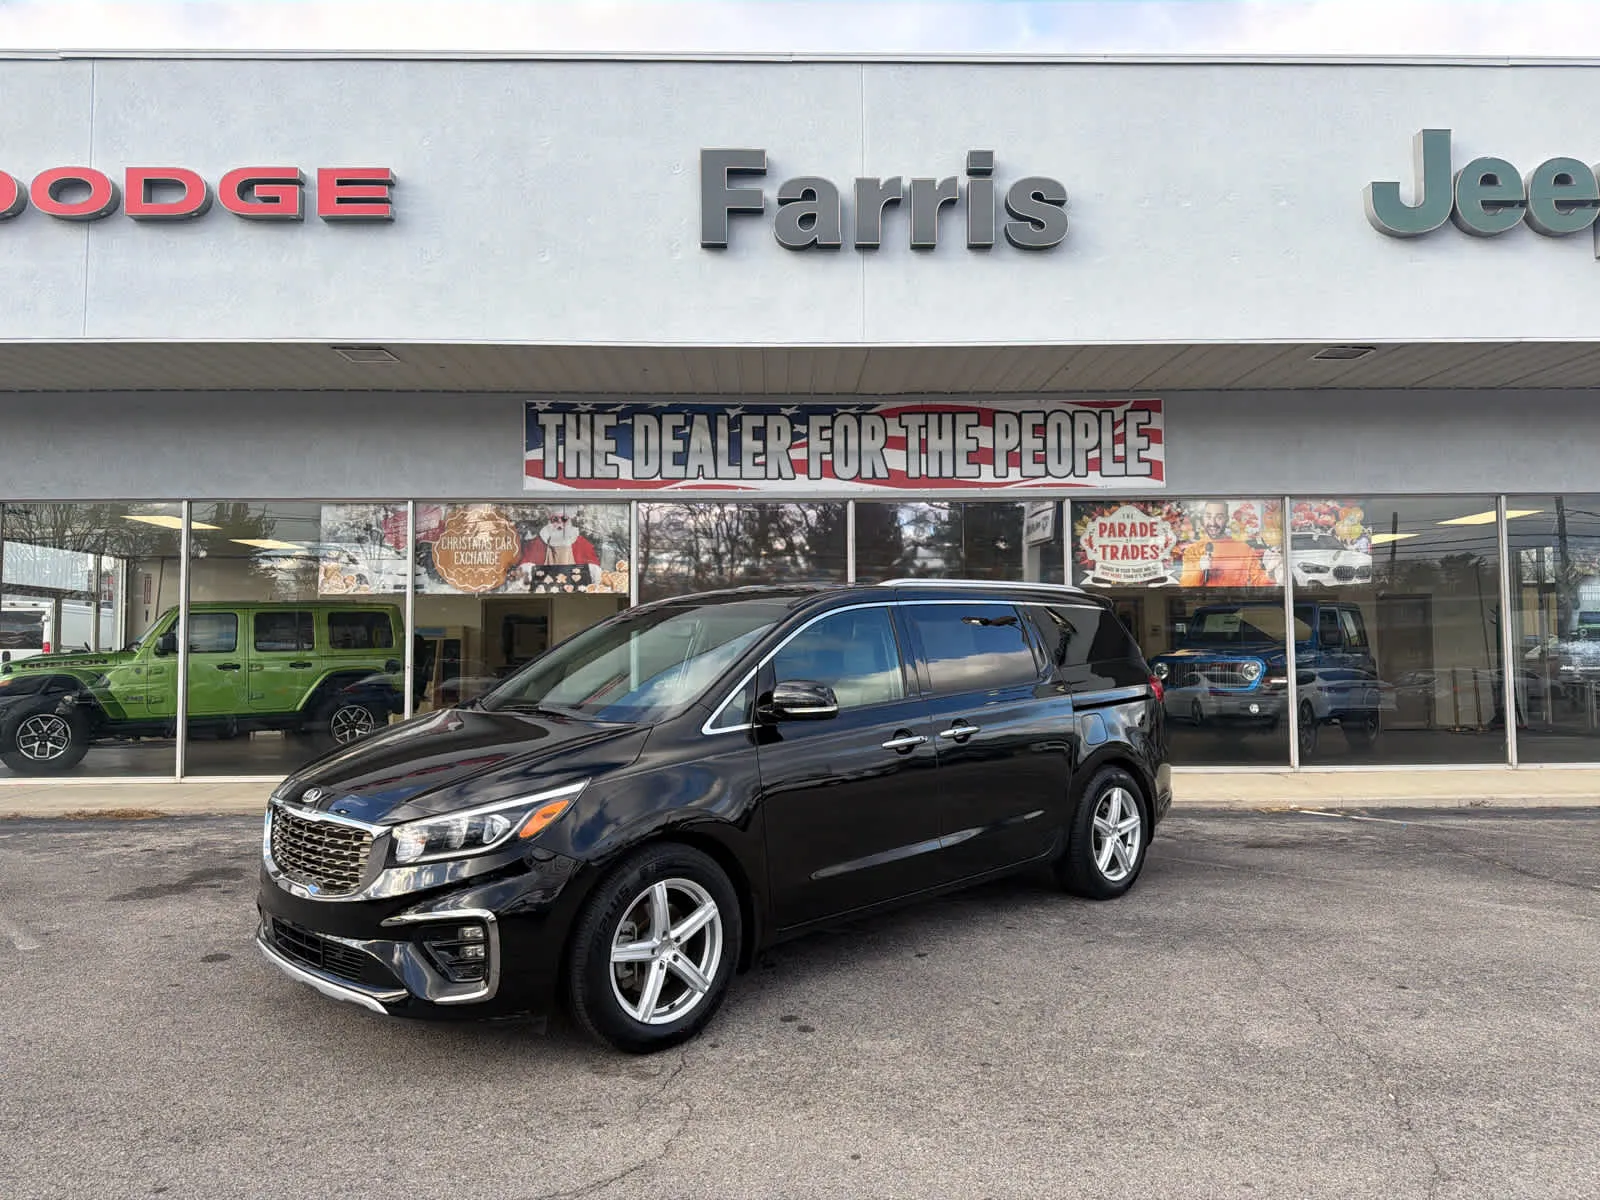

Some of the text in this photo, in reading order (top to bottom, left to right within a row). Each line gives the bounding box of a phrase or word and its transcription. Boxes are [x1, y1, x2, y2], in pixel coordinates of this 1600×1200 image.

[0, 166, 396, 223] ODGE
[700, 147, 1070, 250] Farris
[1361, 129, 1600, 259] Jee
[538, 410, 1152, 480] THE DEALER FOR THE PEOPLE
[441, 535, 513, 551] CHRISTMAS CAR
[1098, 521, 1159, 538] PARADE
[454, 551, 501, 566] EXCHANGE
[1098, 544, 1160, 561] TRADES
